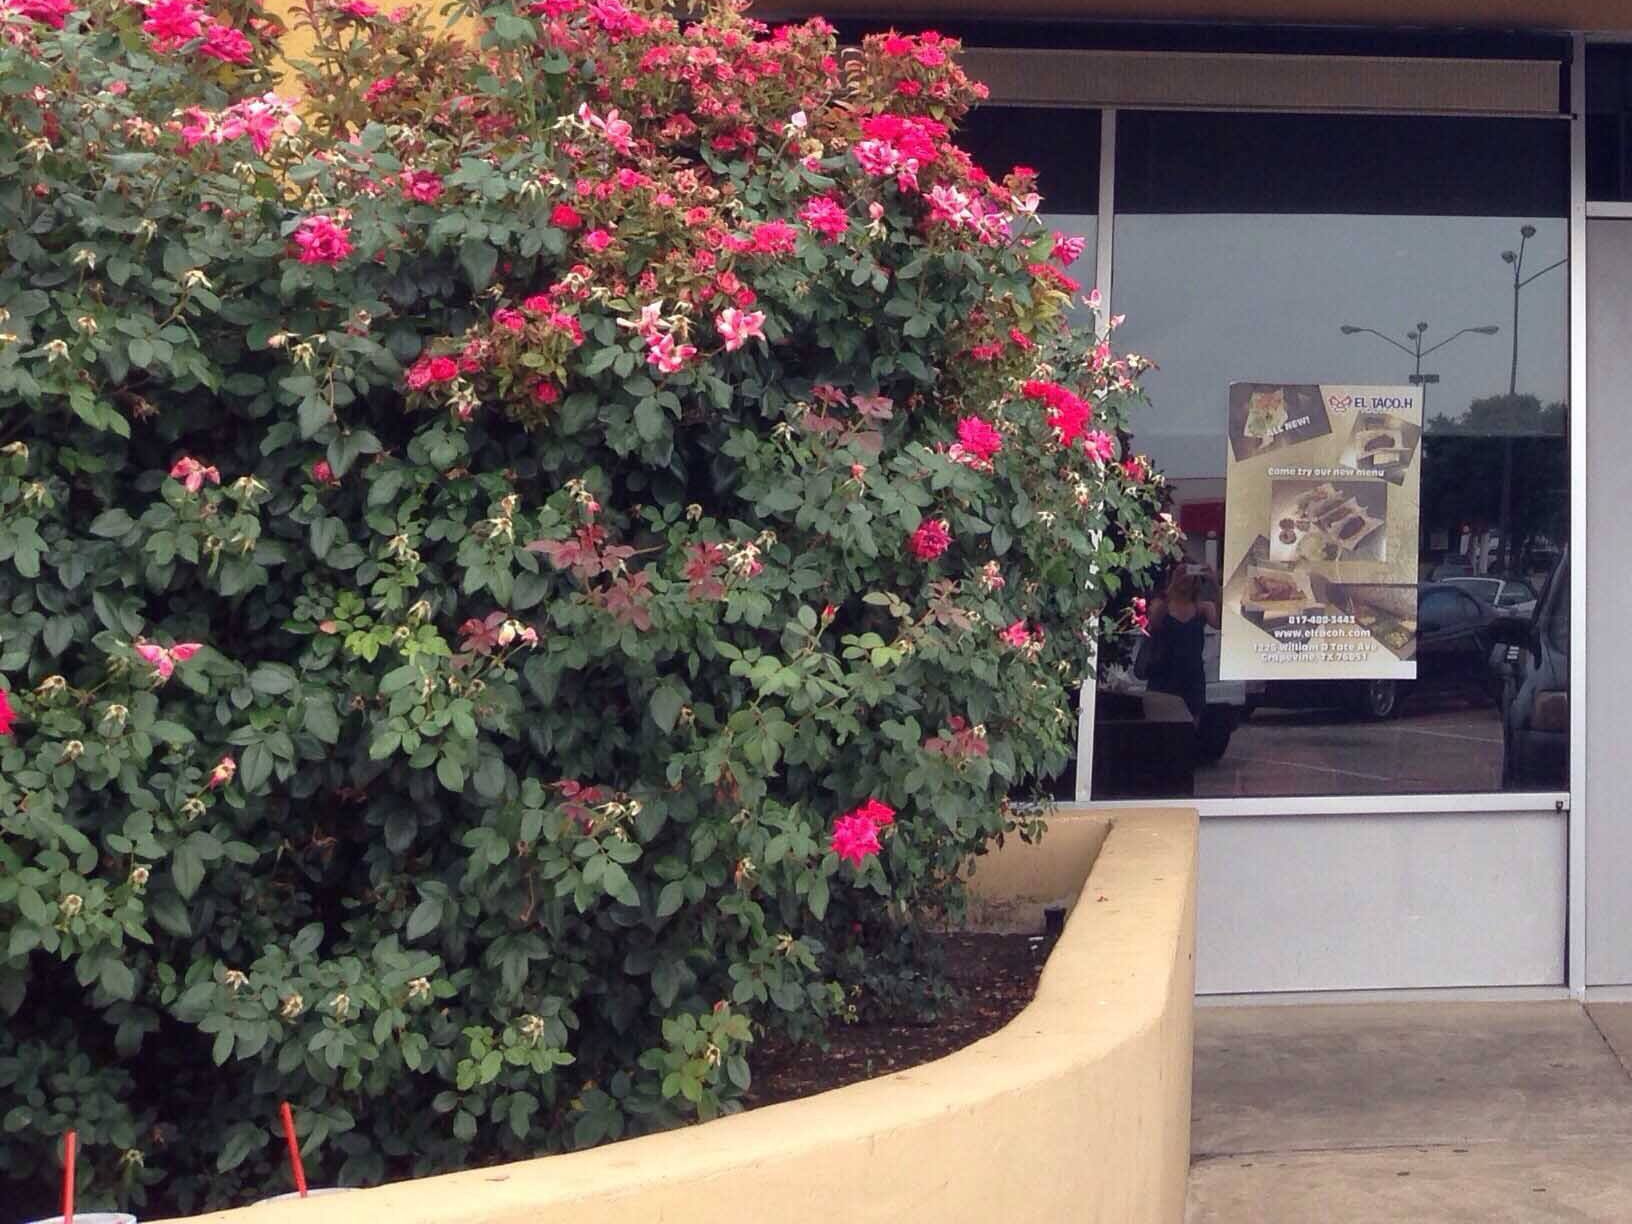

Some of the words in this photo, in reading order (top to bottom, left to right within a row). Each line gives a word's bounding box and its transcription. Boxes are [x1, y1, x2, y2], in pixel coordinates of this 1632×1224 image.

[1354, 397, 1368, 408] EL
[1371, 397, 1413, 409] TACO.H
[1266, 424, 1284, 437] ALL
[1284, 415, 1311, 431] NEW!
[1314, 468, 1331, 476] our
[1333, 467, 1354, 476] new
[1355, 468, 1385, 477] menu
[1274, 629, 1371, 638] www.eltacoh.com
